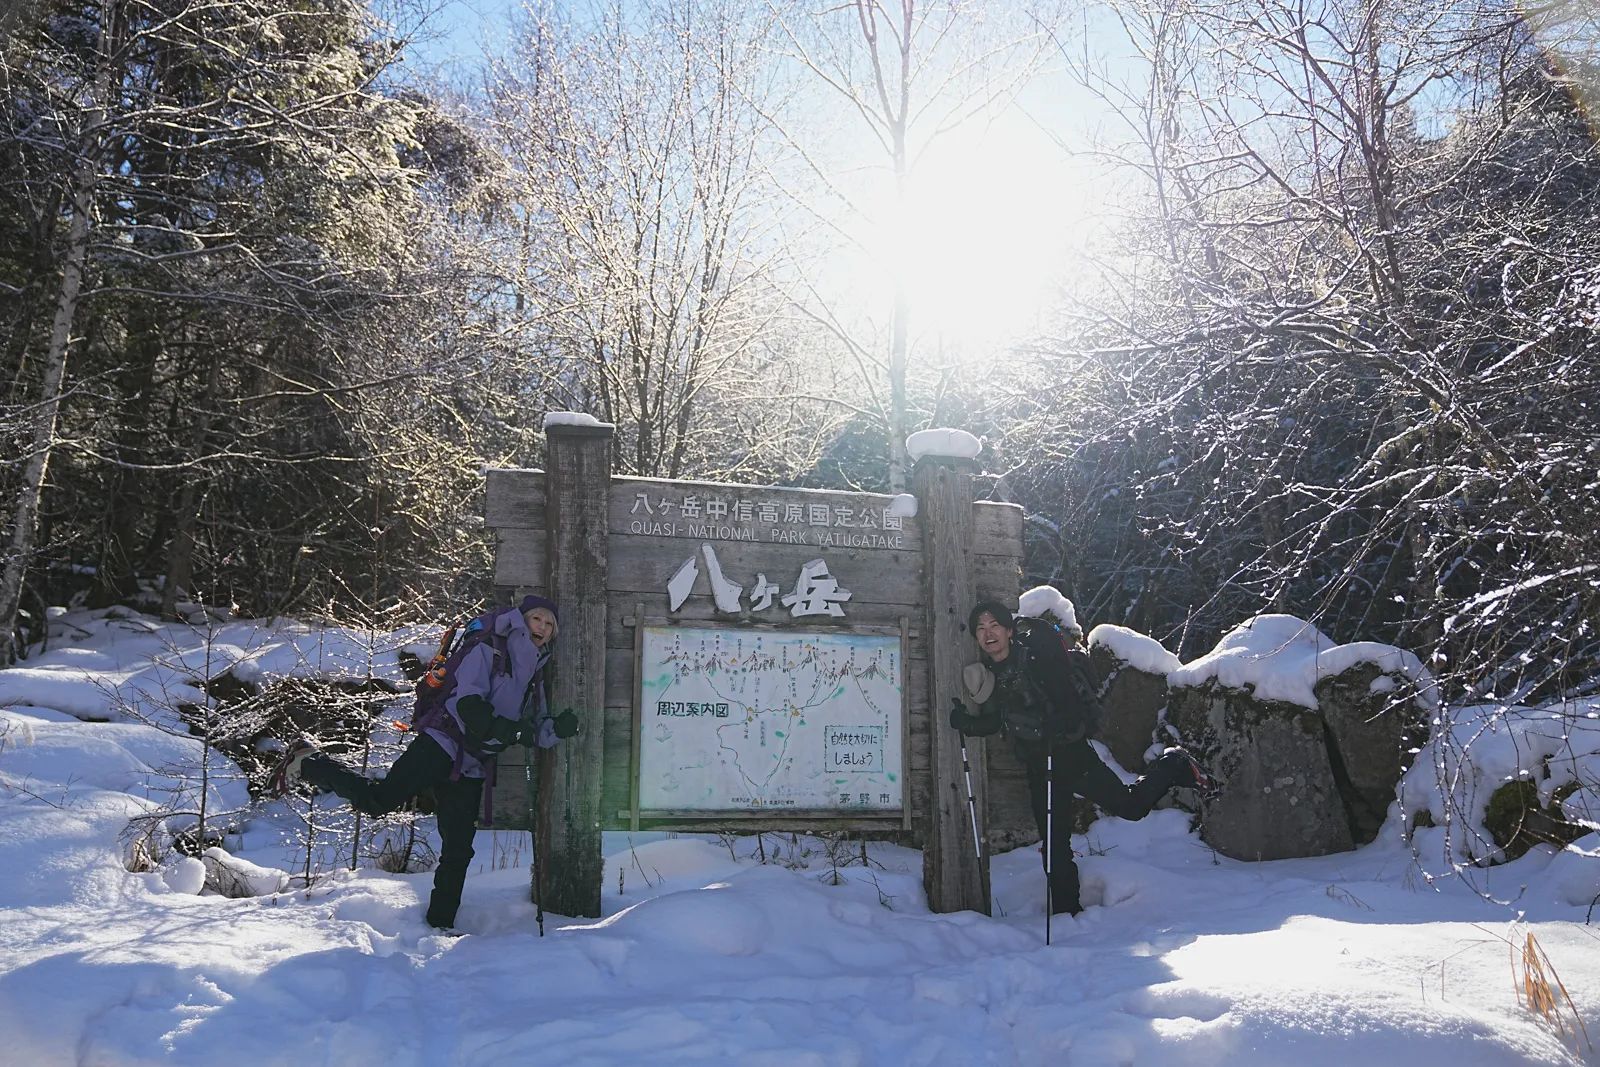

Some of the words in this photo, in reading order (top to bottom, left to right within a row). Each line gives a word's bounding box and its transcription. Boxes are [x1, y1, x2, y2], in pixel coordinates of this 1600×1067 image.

[771, 528, 807, 545] PARK
[817, 532, 902, 550] YATUGATAKE
[656, 701, 729, 718] 周辺案内図
[830, 731, 878, 746] 自然を大切に
[834, 751, 874, 767] しましょう
